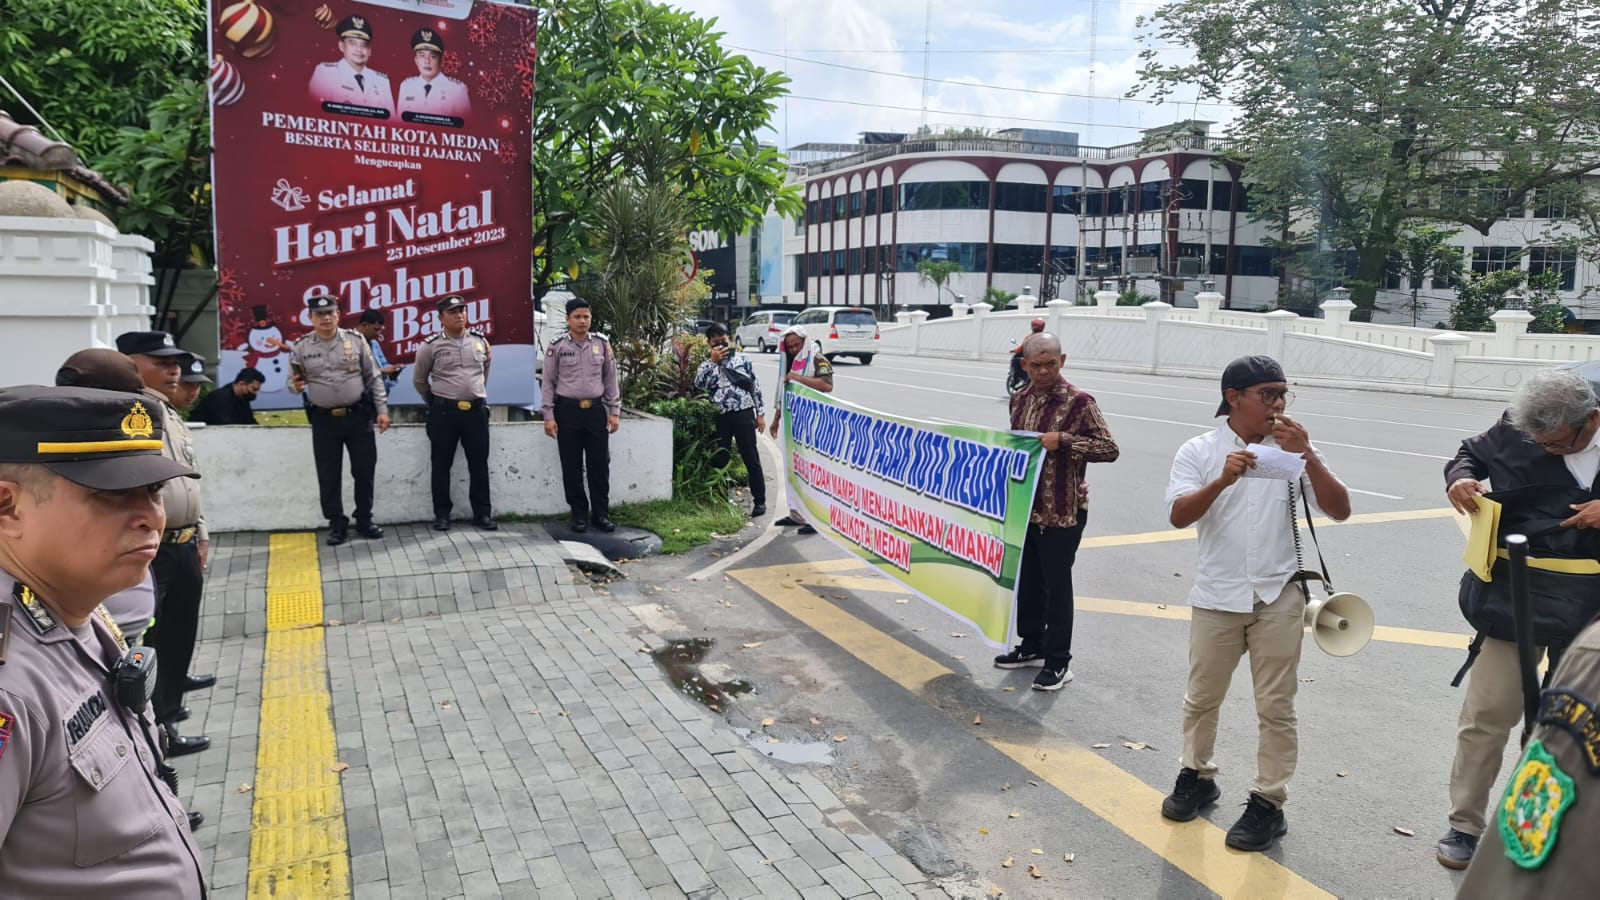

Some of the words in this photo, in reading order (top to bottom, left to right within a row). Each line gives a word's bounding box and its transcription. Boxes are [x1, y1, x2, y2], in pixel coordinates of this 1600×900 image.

[262, 111, 387, 140] PEMERINTAH
[390, 127, 438, 145] KOTA
[441, 133, 500, 152] MEDAN
[284, 131, 351, 151] BESERTA
[354, 139, 421, 157] SELURUH
[423, 147, 482, 163] JAJARAN
[354, 154, 422, 170] Mengucapkan
[318, 178, 416, 212] Selamat
[274, 211, 379, 265] Hari
[387, 189, 494, 245] Natal
[386, 248, 404, 262] 25
[405, 235, 473, 258] Desember
[474, 227, 506, 245] 2023
[340, 266, 475, 316] Tahun
[390, 299, 491, 343] Bau
[815, 403, 850, 459] DIRUT
[844, 412, 873, 468] PUD
[868, 419, 914, 483] PASAR
[907, 429, 951, 498] KOTA
[810, 463, 830, 490] TIDAK
[831, 473, 860, 508] MAMPU
[861, 487, 945, 547] MENJALANKAN
[944, 522, 1005, 577] AMANAH
[829, 503, 871, 549] WALIKOTA
[873, 529, 912, 572] MEDAN
